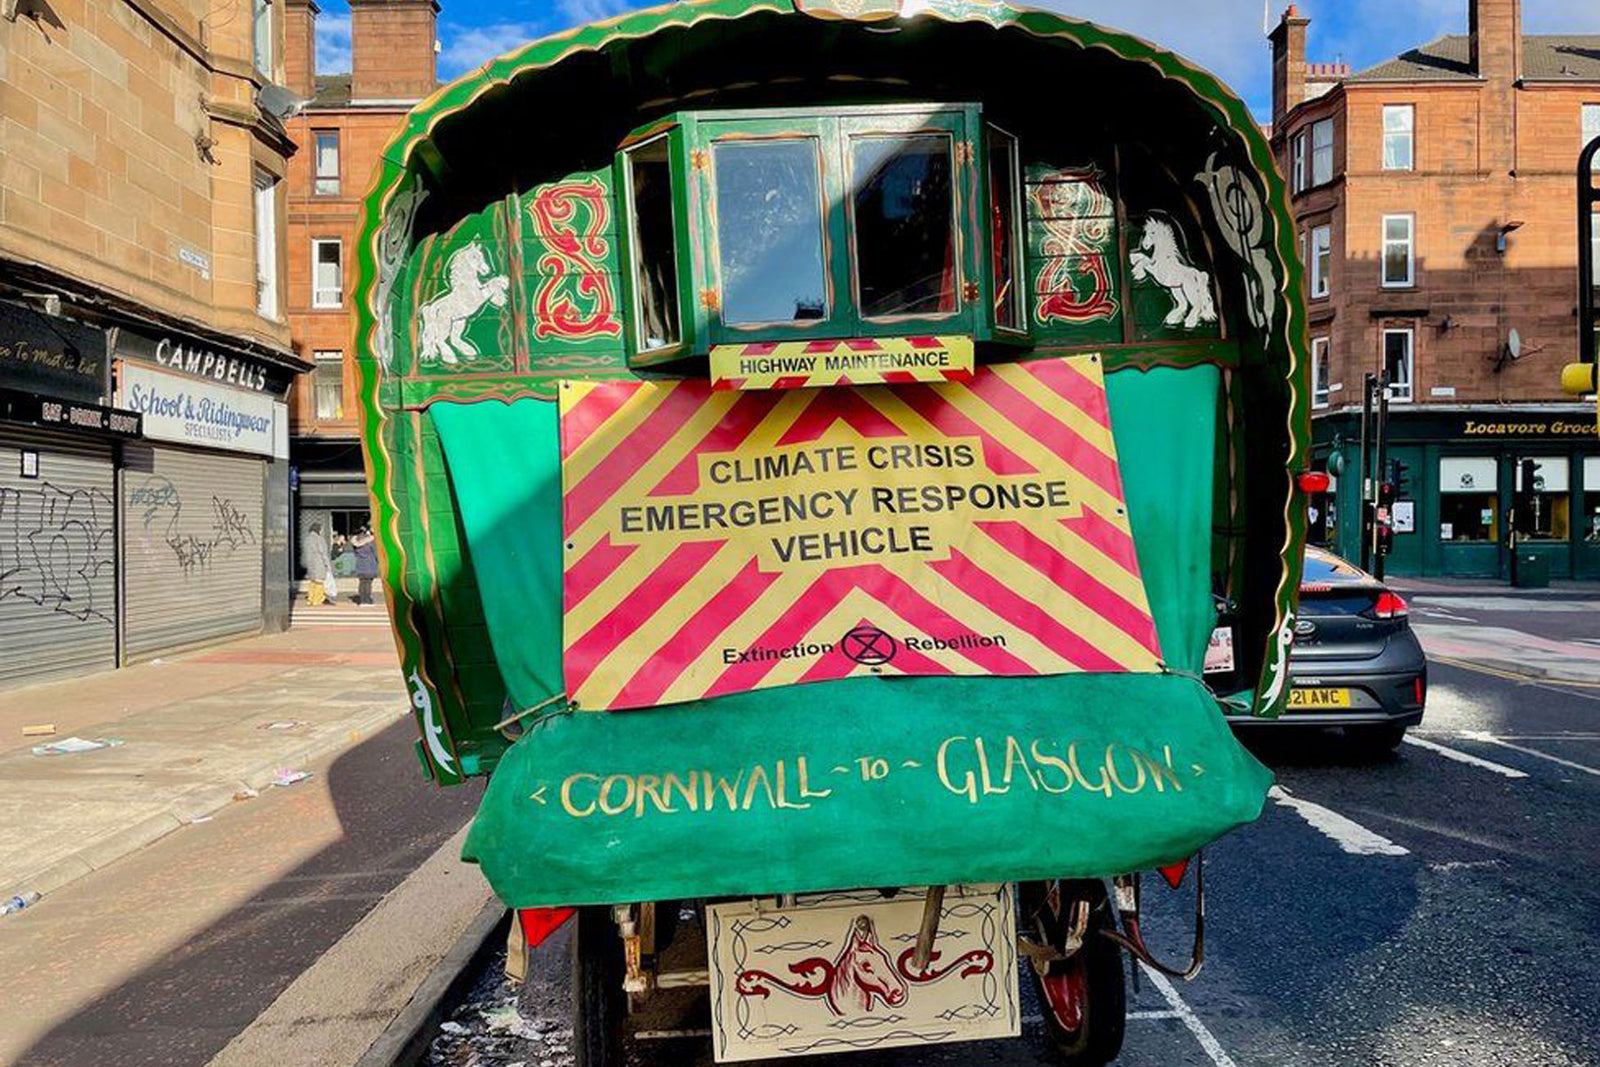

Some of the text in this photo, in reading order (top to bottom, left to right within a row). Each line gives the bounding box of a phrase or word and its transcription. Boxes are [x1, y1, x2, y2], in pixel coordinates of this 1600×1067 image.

[156, 338, 267, 390] CAMPBELL'S
[740, 351, 950, 374] HIGHWAY MAINTENANCE
[129, 384, 271, 437] School & Ridingwear
[1464, 421, 1546, 434] Locavore
[184, 422, 232, 443] SPECIALISTS
[709, 444, 975, 484] CLIMATE CRISIS
[620, 481, 1071, 534] EMERGENCY RESPONSE
[771, 526, 933, 563] VEHICLE
[722, 633, 1006, 664] Extinction Rebellion
[1311, 689, 1340, 704] AWC
[561, 756, 832, 818] CORNWALL
[937, 735, 1183, 803] GLASGOW
